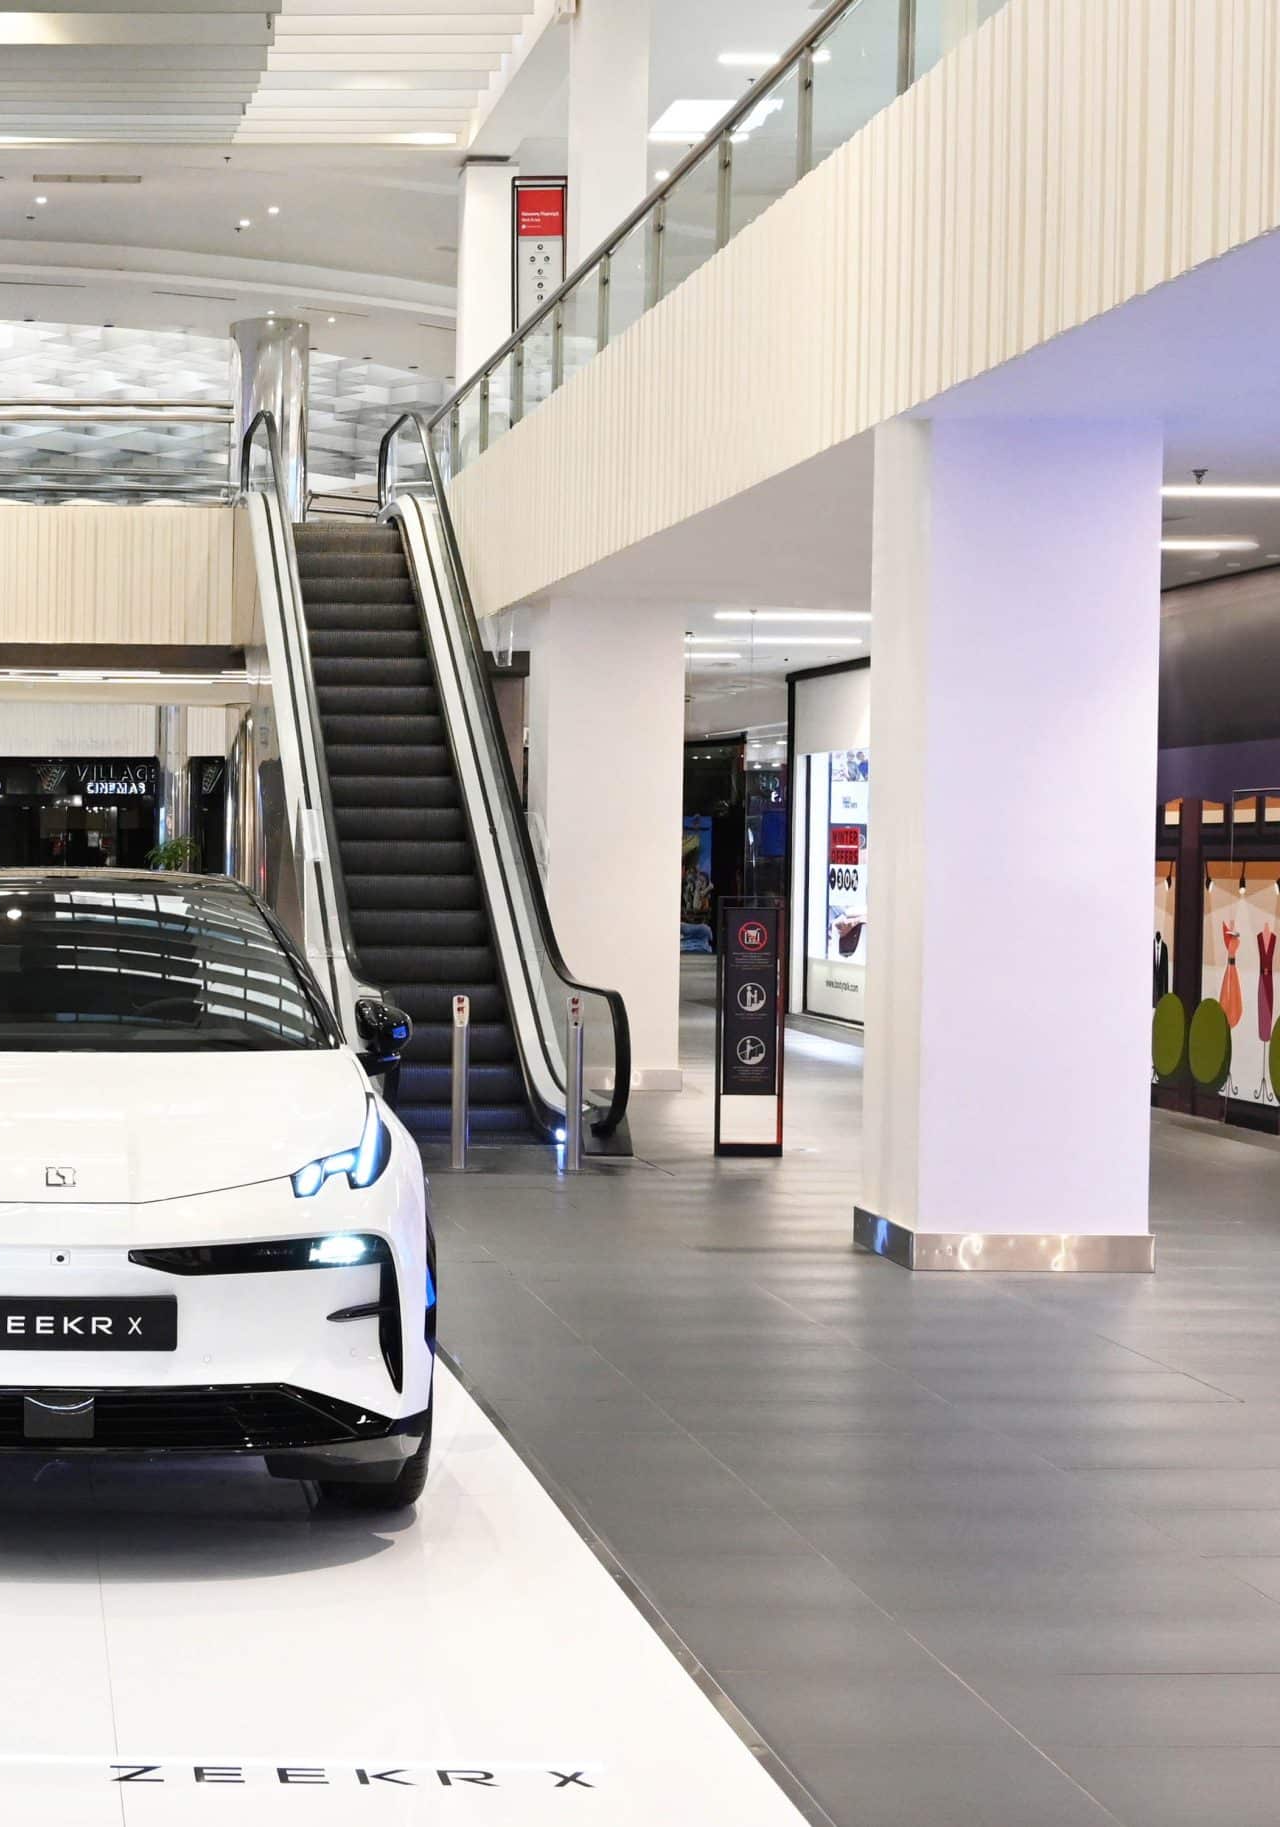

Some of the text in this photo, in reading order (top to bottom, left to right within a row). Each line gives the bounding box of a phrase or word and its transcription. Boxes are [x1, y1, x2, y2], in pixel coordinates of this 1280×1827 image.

[86, 782, 146, 795] CINEMAS
[831, 830, 858, 846] WINTER
[831, 849, 858, 864] OFFERS
[127, 1316, 143, 1335] X
[110, 1765, 596, 1789] ZEEKR X
